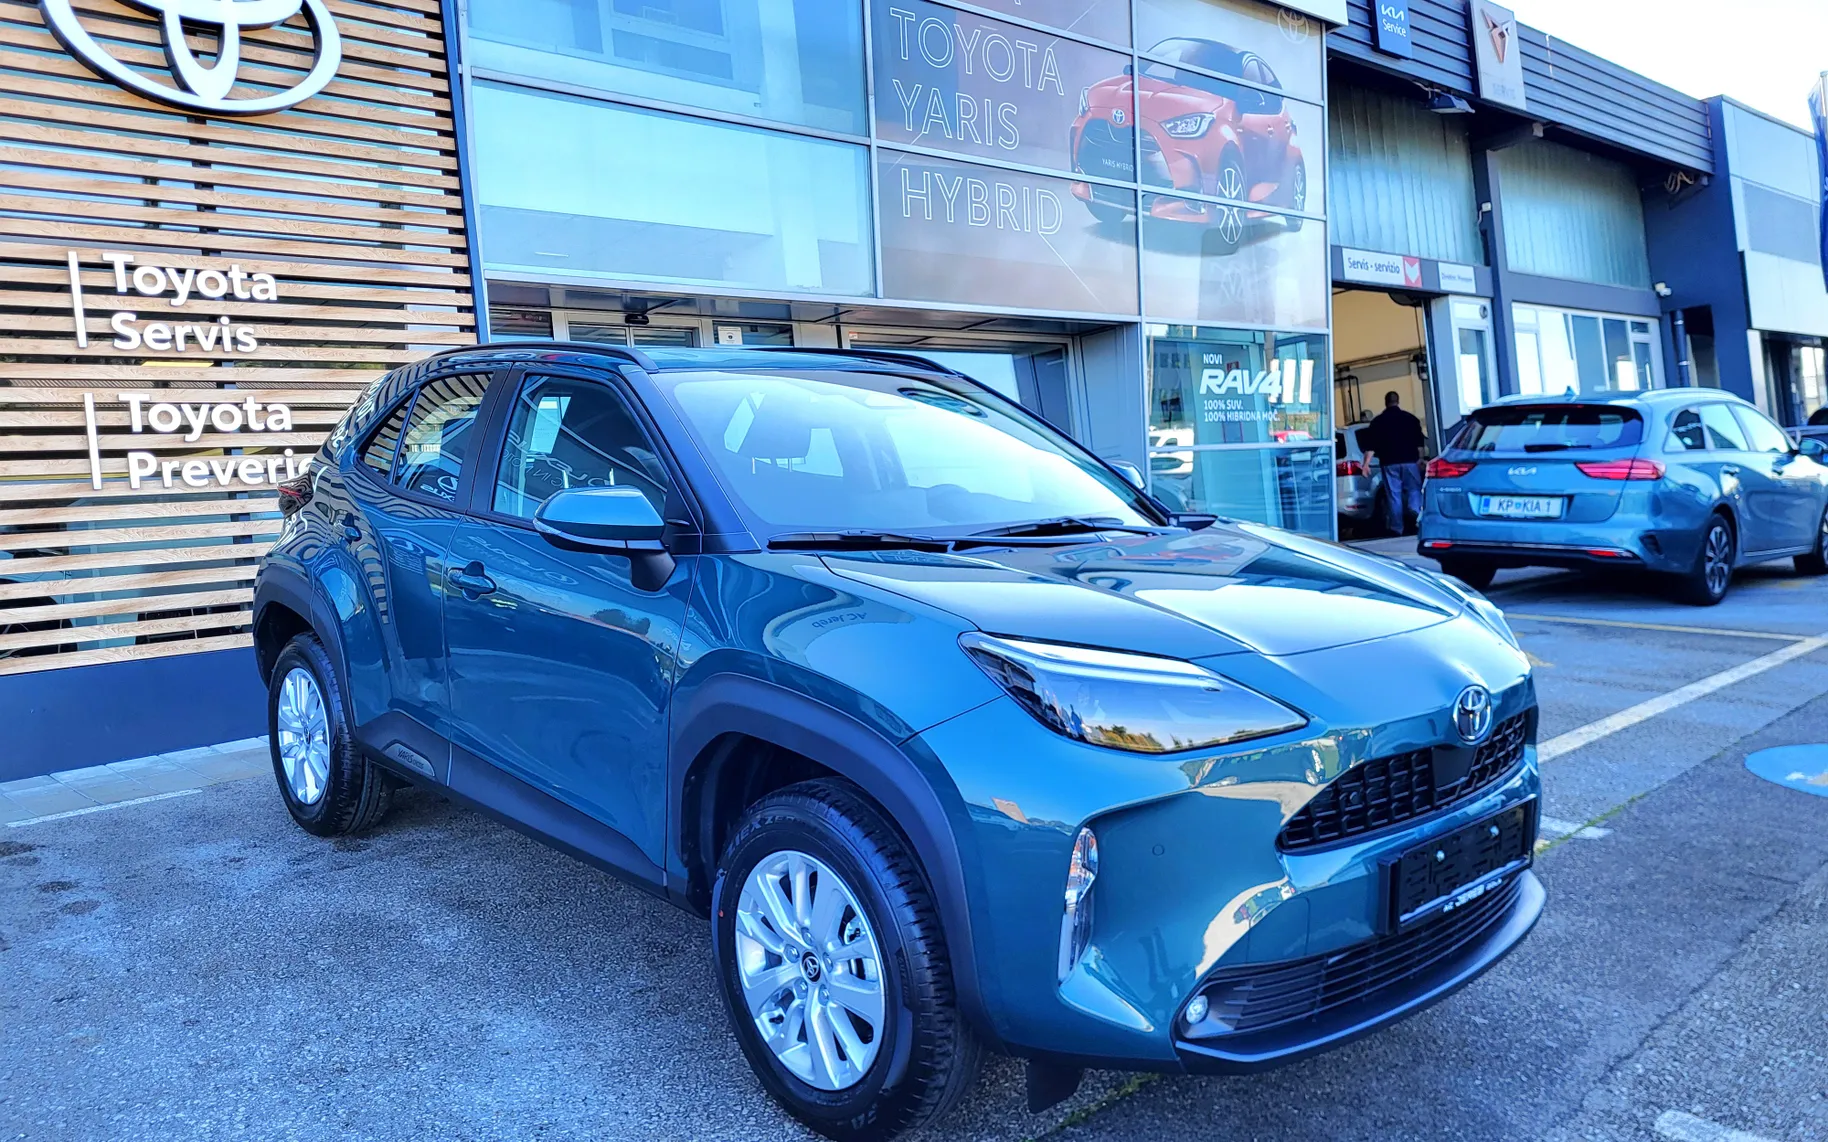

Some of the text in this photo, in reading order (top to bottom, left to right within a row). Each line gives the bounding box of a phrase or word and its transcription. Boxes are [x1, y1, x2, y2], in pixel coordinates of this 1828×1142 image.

[1382, 18, 1407, 37] Service
[889, 7, 1065, 96] TOYOTA
[892, 79, 1020, 150] YARIS
[901, 167, 1063, 235] HYBRID
[1347, 256, 1369, 271] Servis
[102, 252, 278, 307] Toyota
[110, 312, 258, 353] Servis
[1203, 353, 1223, 365] NOVI
[1200, 368, 1282, 395] RAV4
[118, 393, 293, 443] Toyota
[1204, 399, 1226, 411] 100%
[1204, 411, 1226, 422] 100%
[1497, 498, 1513, 511] KP
[1523, 499, 1541, 512] KIA
